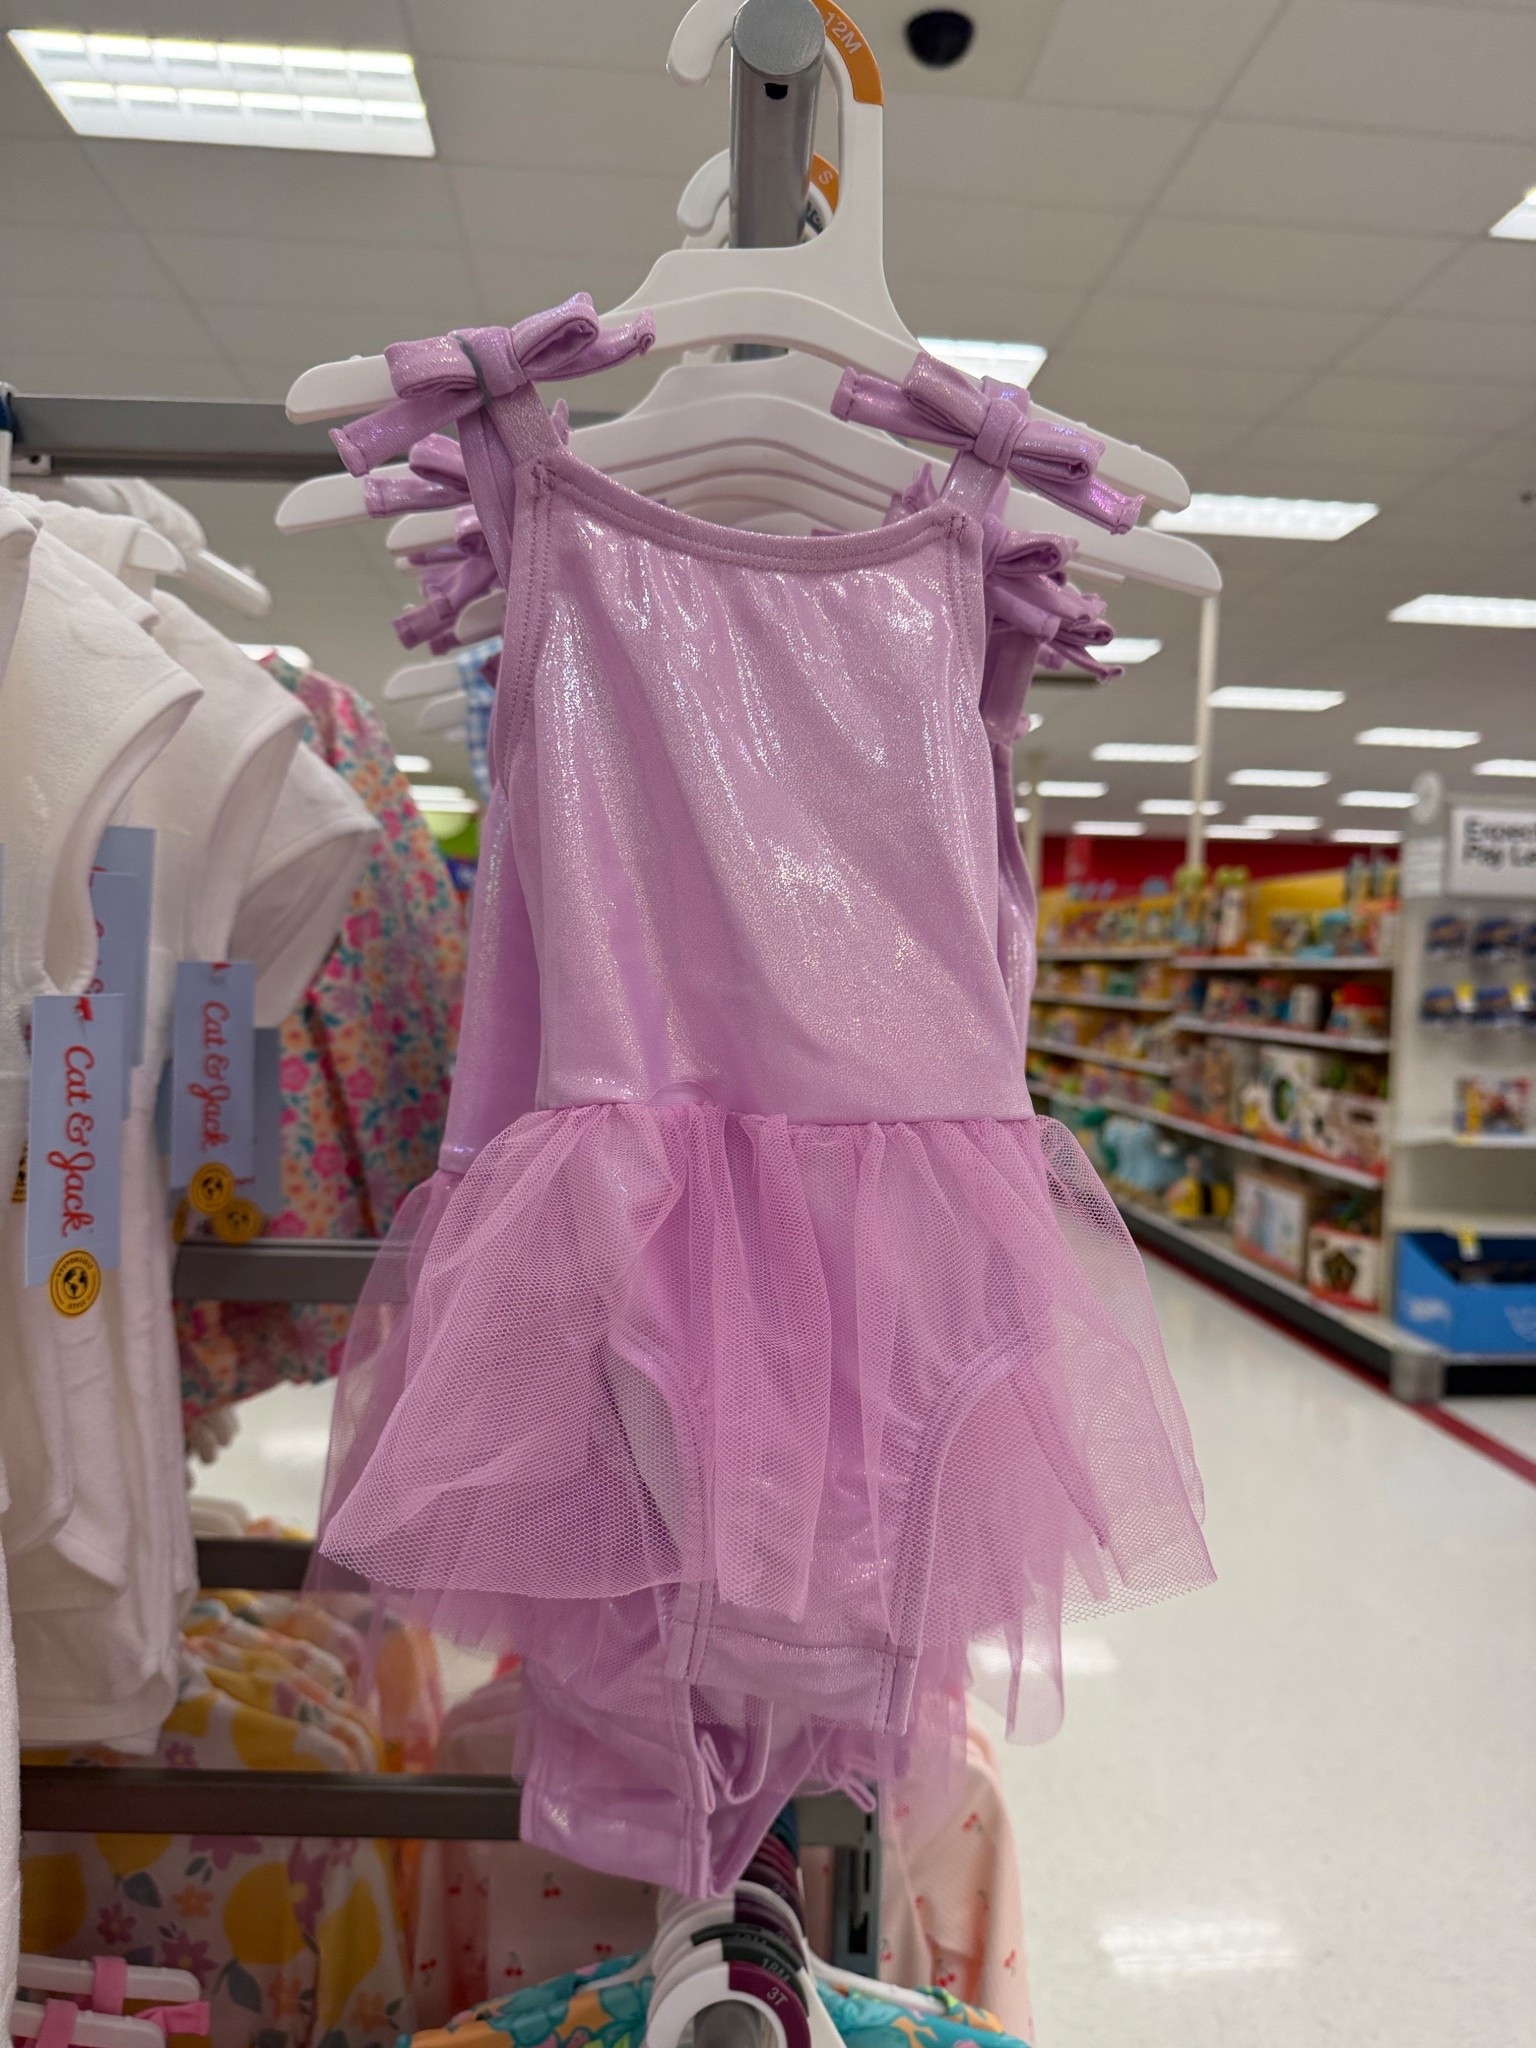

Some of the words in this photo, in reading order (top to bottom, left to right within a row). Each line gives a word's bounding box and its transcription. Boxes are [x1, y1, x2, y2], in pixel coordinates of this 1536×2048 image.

[825, 11, 862, 54] 12M
[819, 170, 834, 185] S
[203, 1001, 231, 1049] Cat
[64, 1045, 95, 1106] Cat
[203, 1053, 230, 1081] &
[65, 1112, 95, 1146] &
[188, 1082, 231, 1152] Jack
[47, 1151, 96, 1238] Jack
[766, 1986, 789, 2006] 3T
